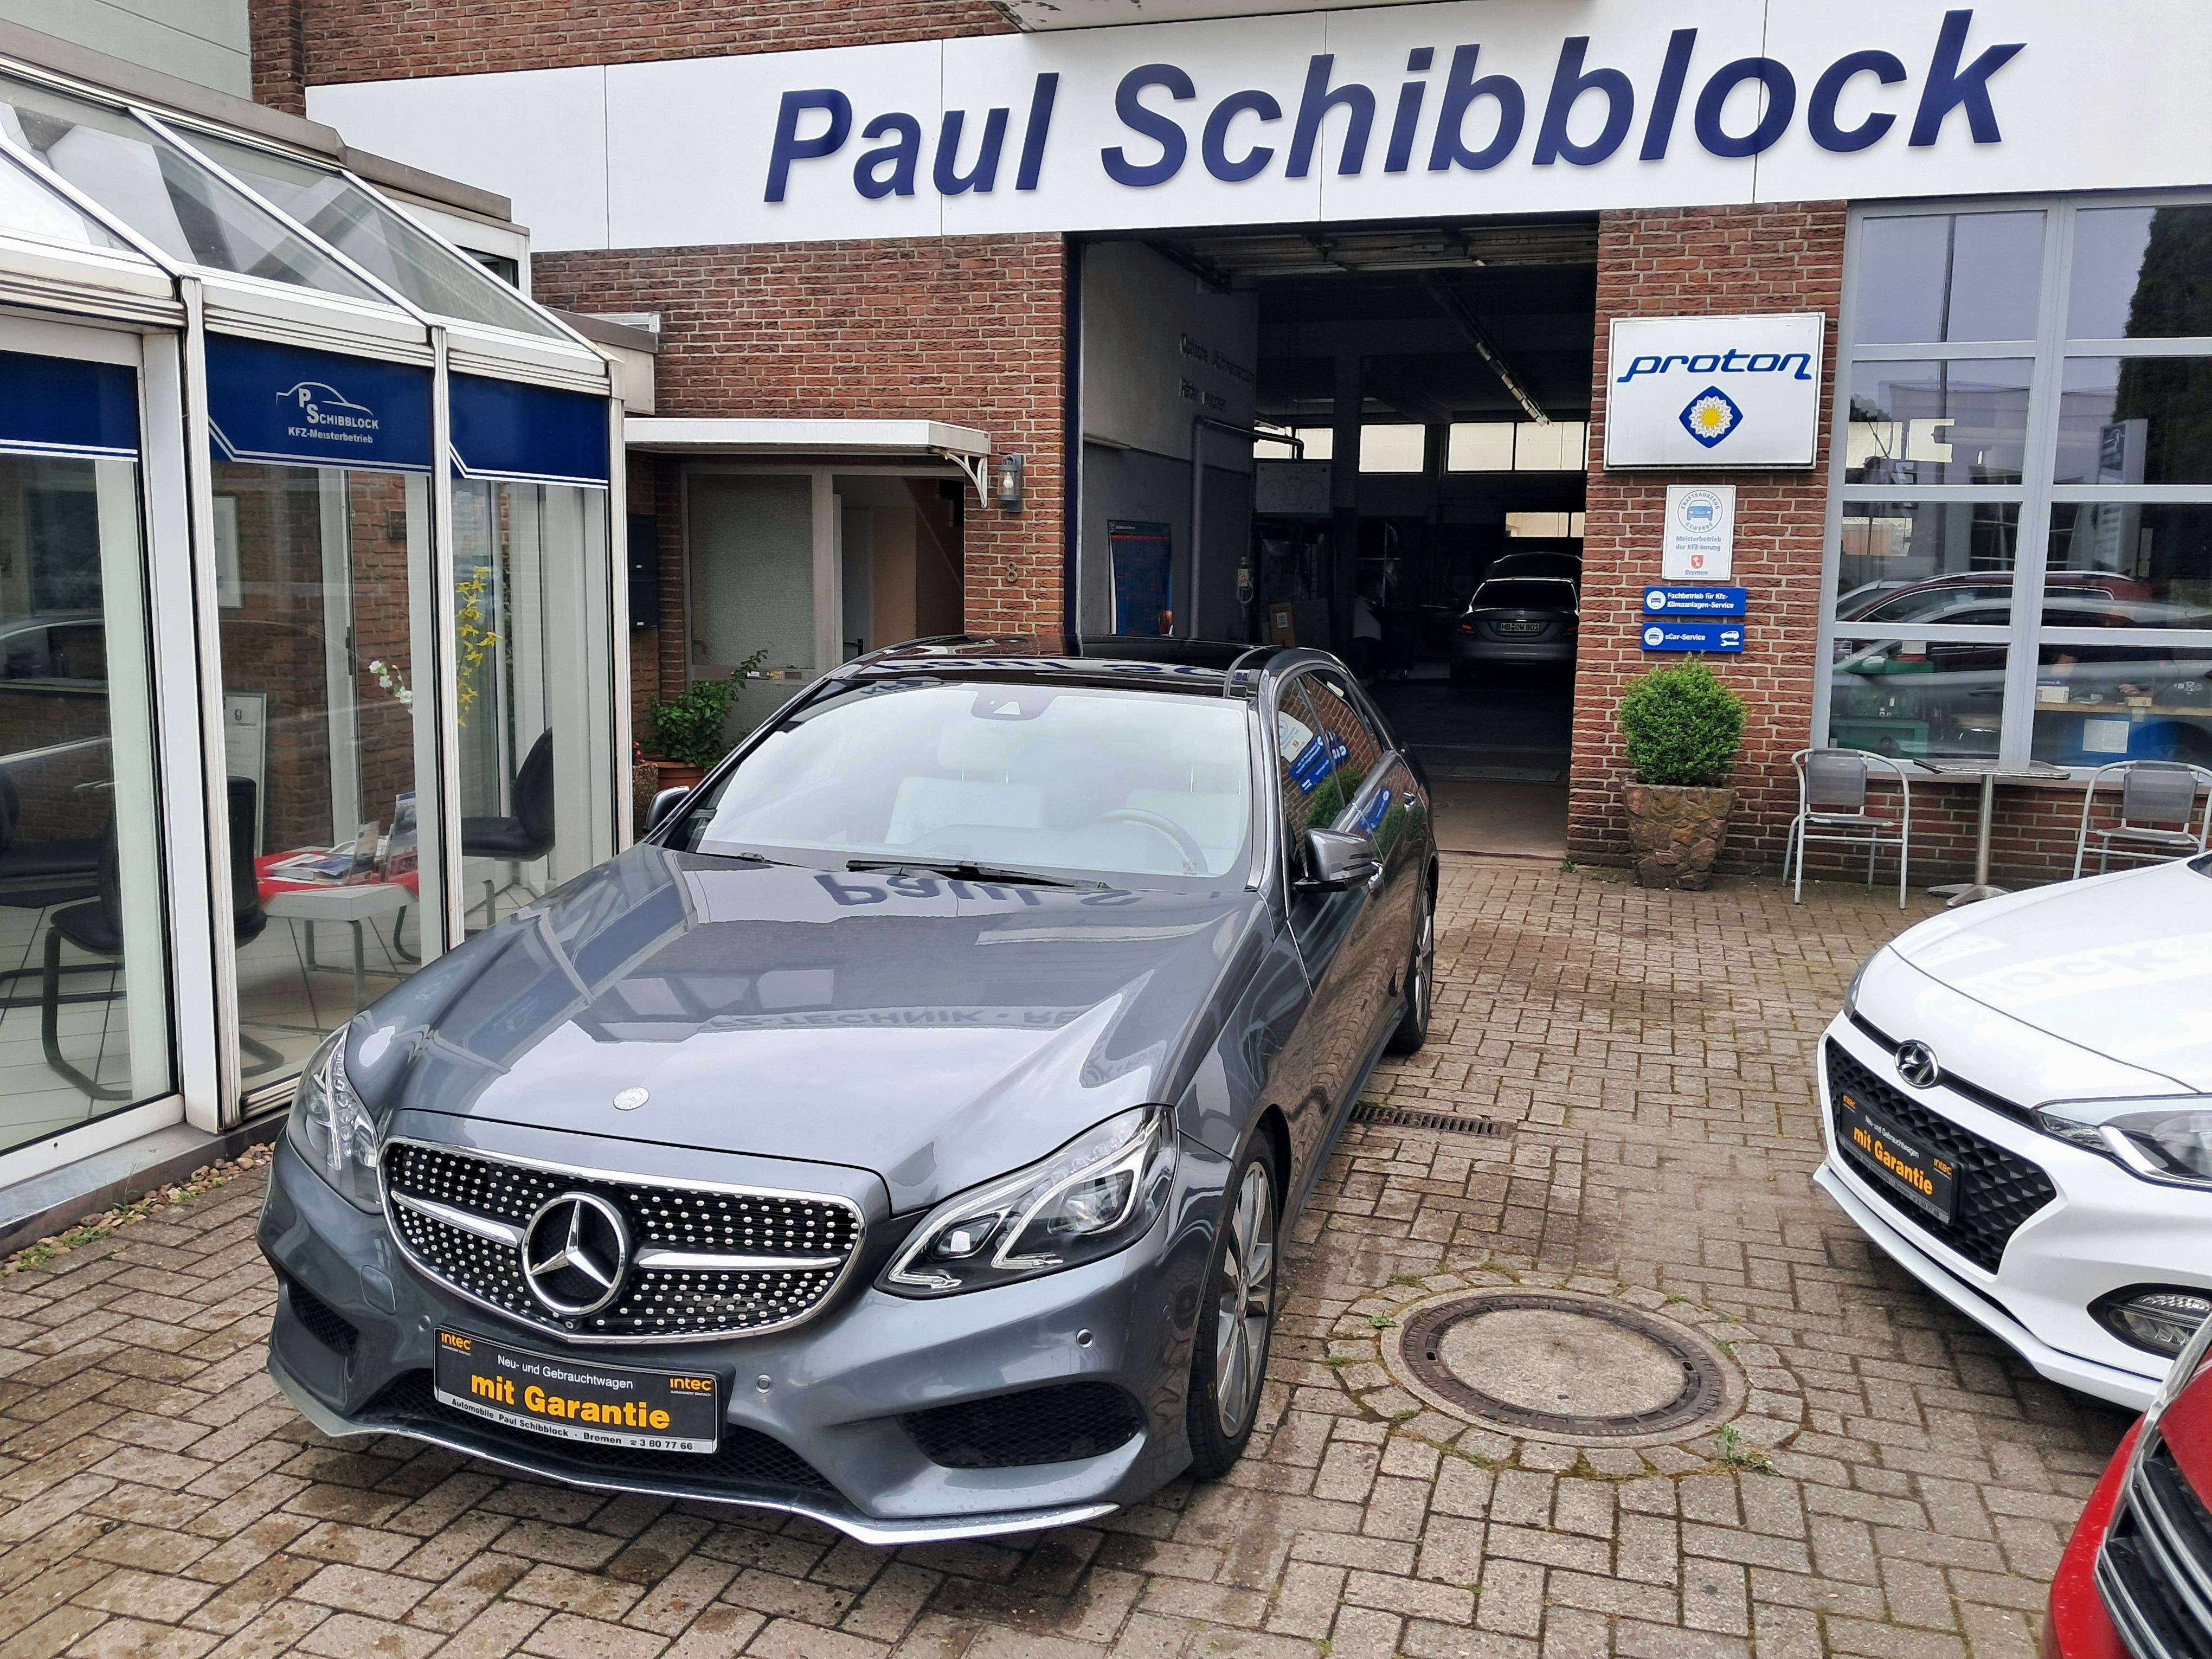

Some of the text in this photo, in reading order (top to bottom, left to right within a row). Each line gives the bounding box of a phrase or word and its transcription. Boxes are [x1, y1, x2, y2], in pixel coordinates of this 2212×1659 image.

[763, 9, 2028, 203] Paul Schibblock
[1616, 349, 1812, 383] proton
[288, 427, 374, 444] KFZ-Meisterbetrieb
[1681, 492, 1720, 510] KRAFTFAHRZEUG
[1006, 561, 1018, 583] 8
[1667, 601, 1734, 609] Klimaanlagen-Service
[1854, 1126, 1872, 1152] mit
[1874, 1140, 1933, 1195] Garantie
[1933, 1158, 1952, 1175] intec
[441, 1333, 471, 1351] intec
[498, 1354, 633, 1391] Neu- und Gebrauchtwagen
[670, 1378, 711, 1391] intec
[471, 1372, 671, 1430] mit Garantie
[452, 1398, 693, 1450] Automobile Paul Schibblock Bremen 3 80 77 66
